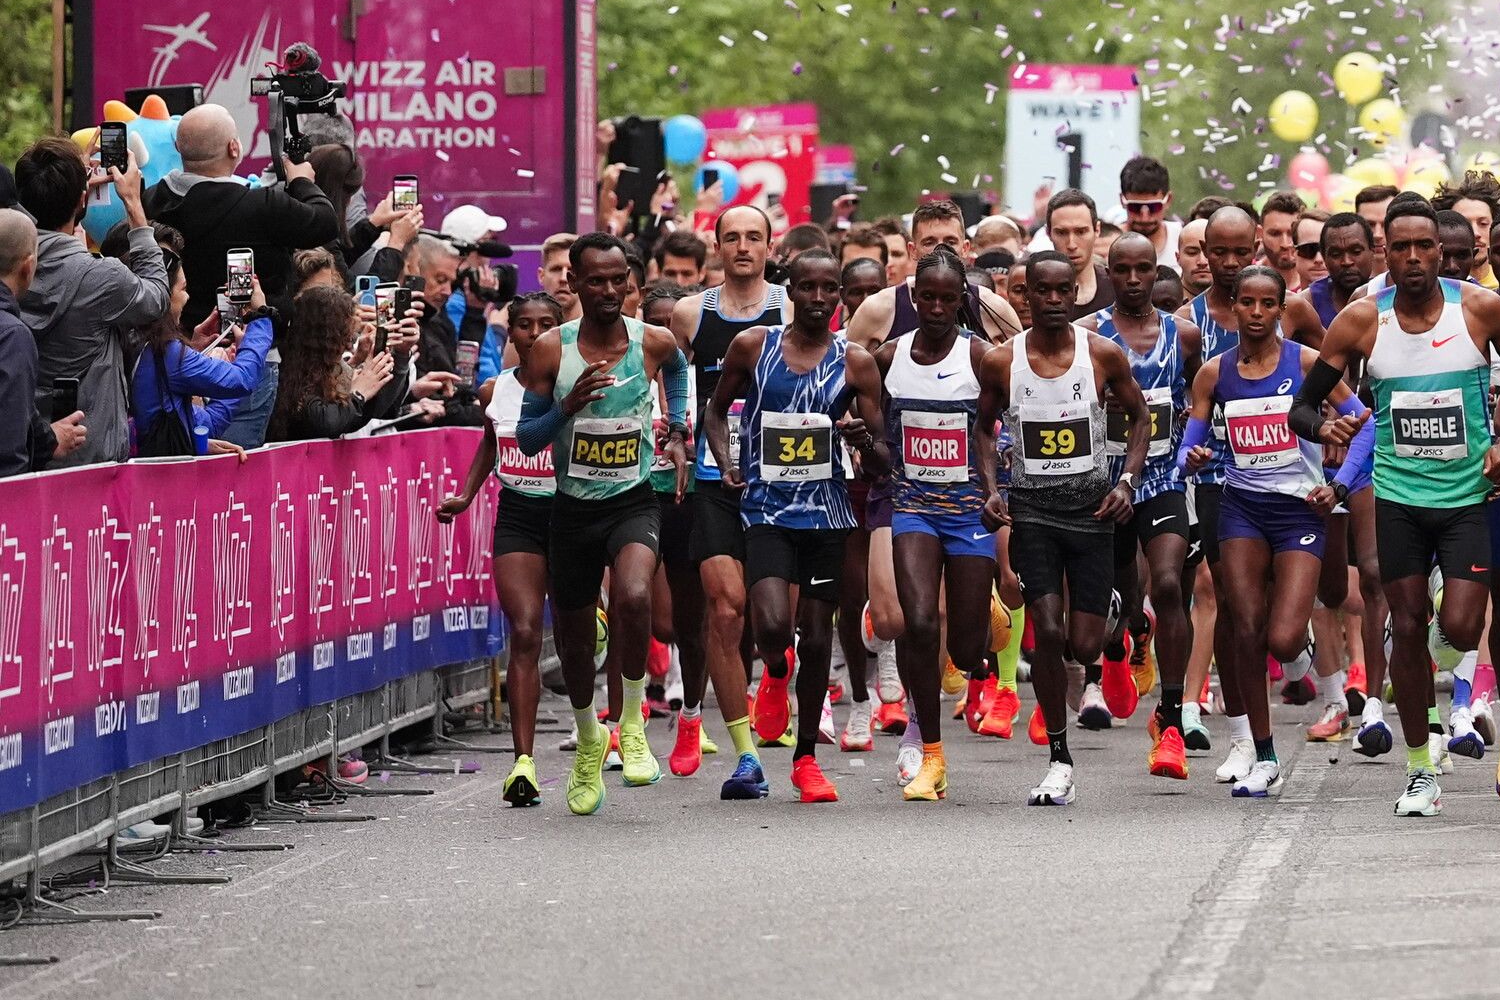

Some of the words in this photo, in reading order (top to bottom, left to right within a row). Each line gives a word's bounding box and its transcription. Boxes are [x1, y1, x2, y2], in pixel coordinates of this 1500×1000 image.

[331, 60, 427, 88] WIZZ
[434, 60, 496, 87] AIR
[333, 90, 498, 123] MILANO
[355, 126, 496, 149] ARATHON
[1235, 421, 1291, 448] KALAYU
[1400, 416, 1457, 440] DEBELE
[576, 439, 637, 465] PACER
[778, 436, 816, 463] 34
[911, 436, 959, 461] KORIR
[1040, 428, 1076, 456] 39
[1423, 448, 1444, 456] asics
[1051, 461, 1071, 470] asics
[1259, 454, 1278, 463] asics
[927, 469, 946, 477] asics
